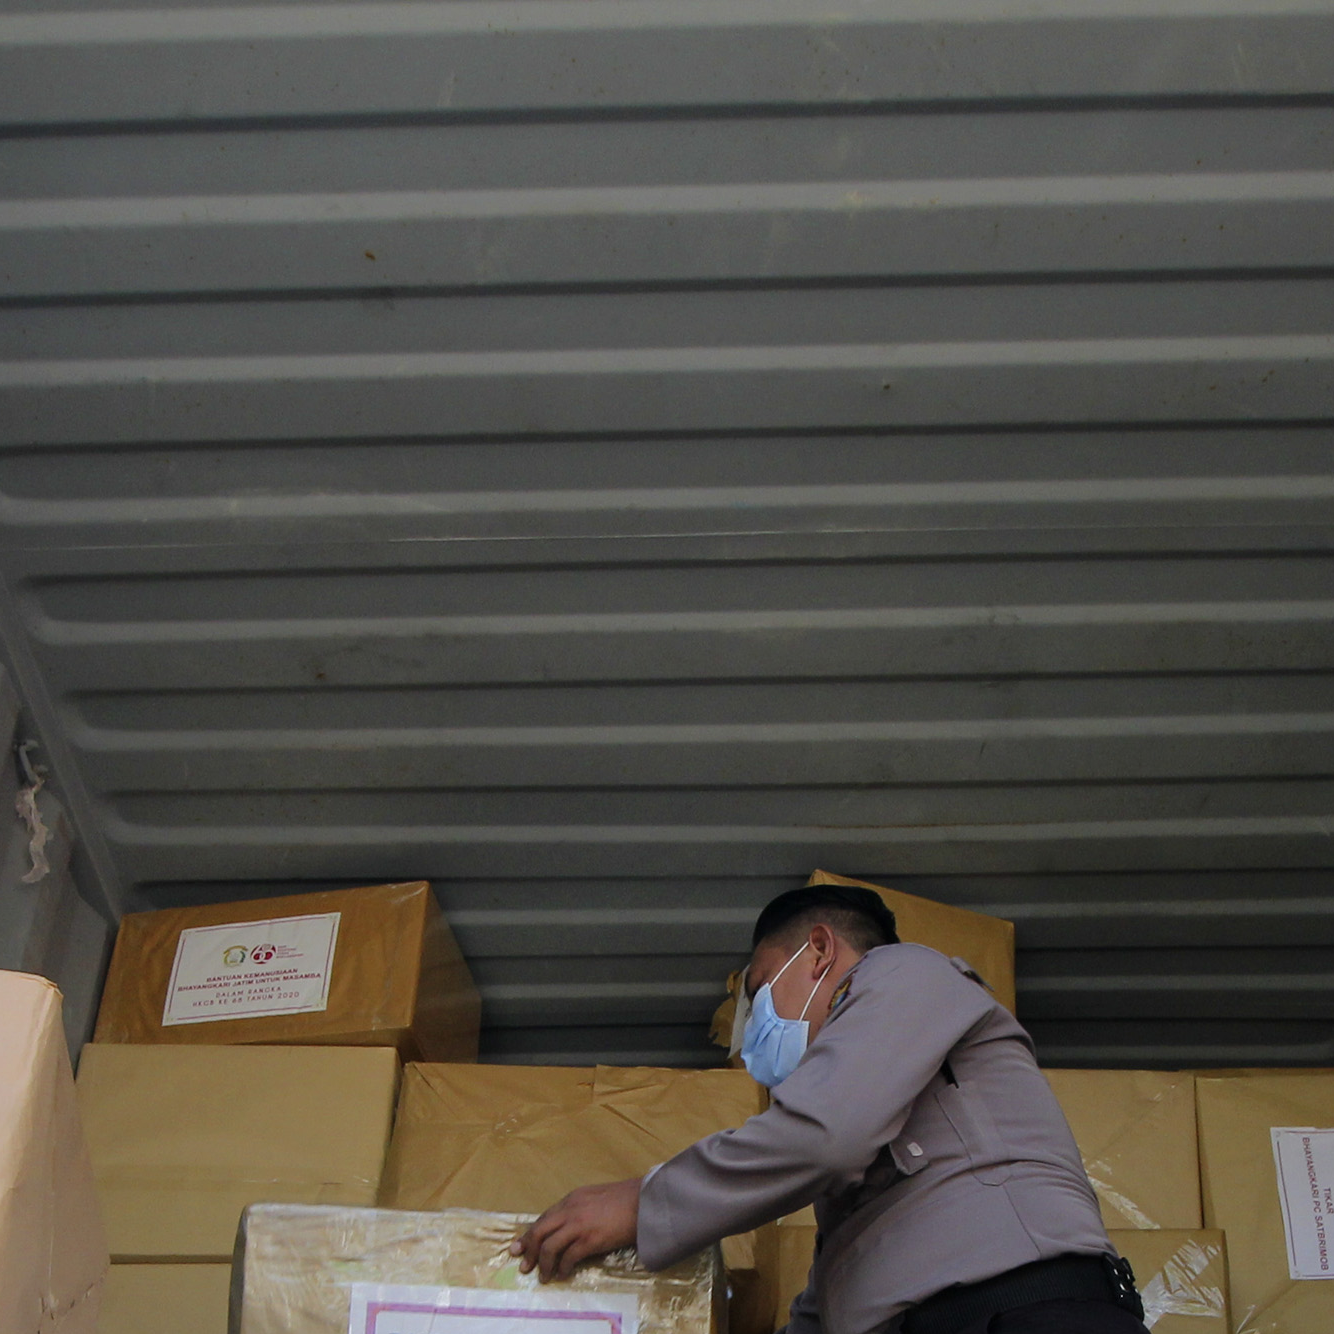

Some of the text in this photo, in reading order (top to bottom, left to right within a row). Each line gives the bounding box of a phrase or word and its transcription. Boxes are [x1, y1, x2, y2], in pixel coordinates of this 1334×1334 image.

[178, 983, 230, 992] BHAYANGKARI
[283, 973, 321, 981] MASAMBA
[1302, 1137, 1329, 1271] BHAYANGKARI PC SATBRIMOB
[1323, 1188, 1334, 1215] TIKAR
